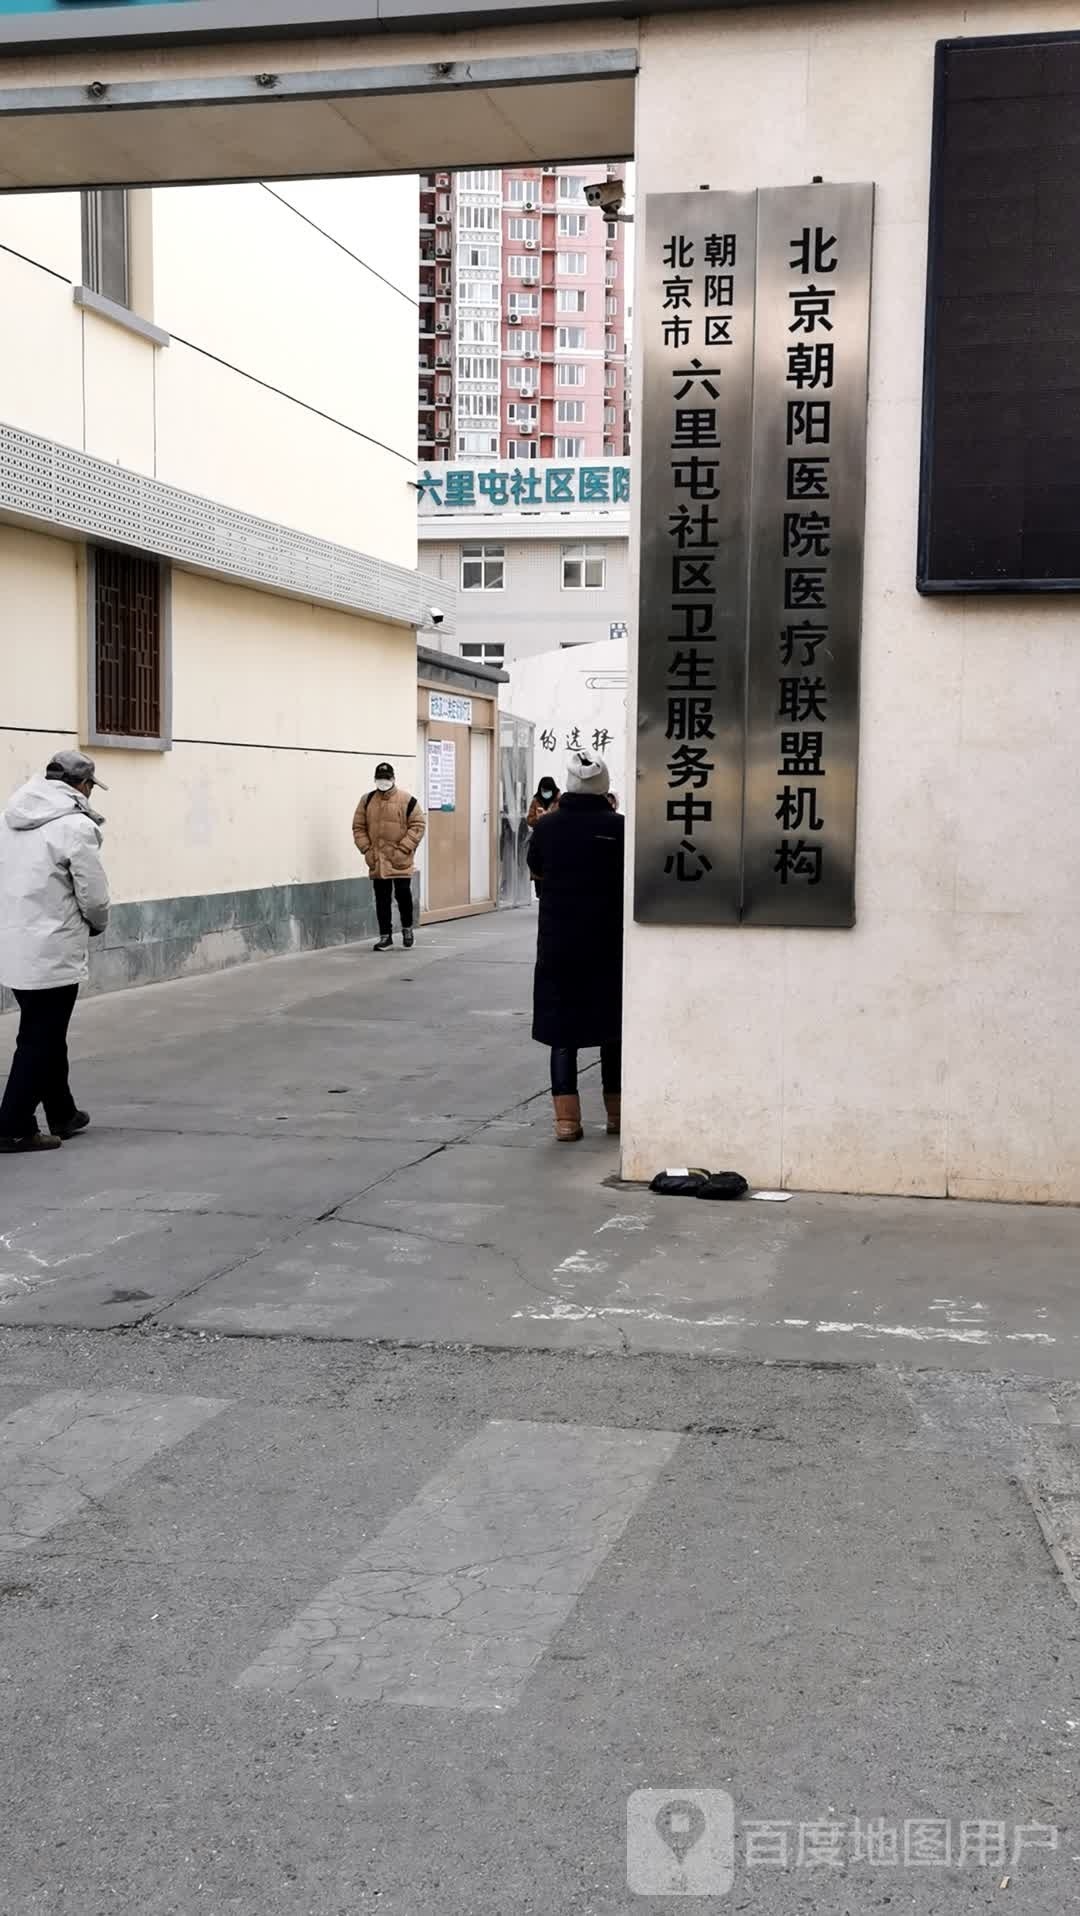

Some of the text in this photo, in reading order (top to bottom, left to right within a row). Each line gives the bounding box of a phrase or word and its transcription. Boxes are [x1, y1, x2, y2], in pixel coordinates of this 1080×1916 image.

[661, 235, 694, 348] 北京市
[704, 233, 737, 346] 朝阳区
[774, 227, 838, 885] 北京朝阳医院医疗联盟机构
[664, 358, 722, 882] 六里屯社区卫生服务中心
[540, 726, 615, 755] 的选择
